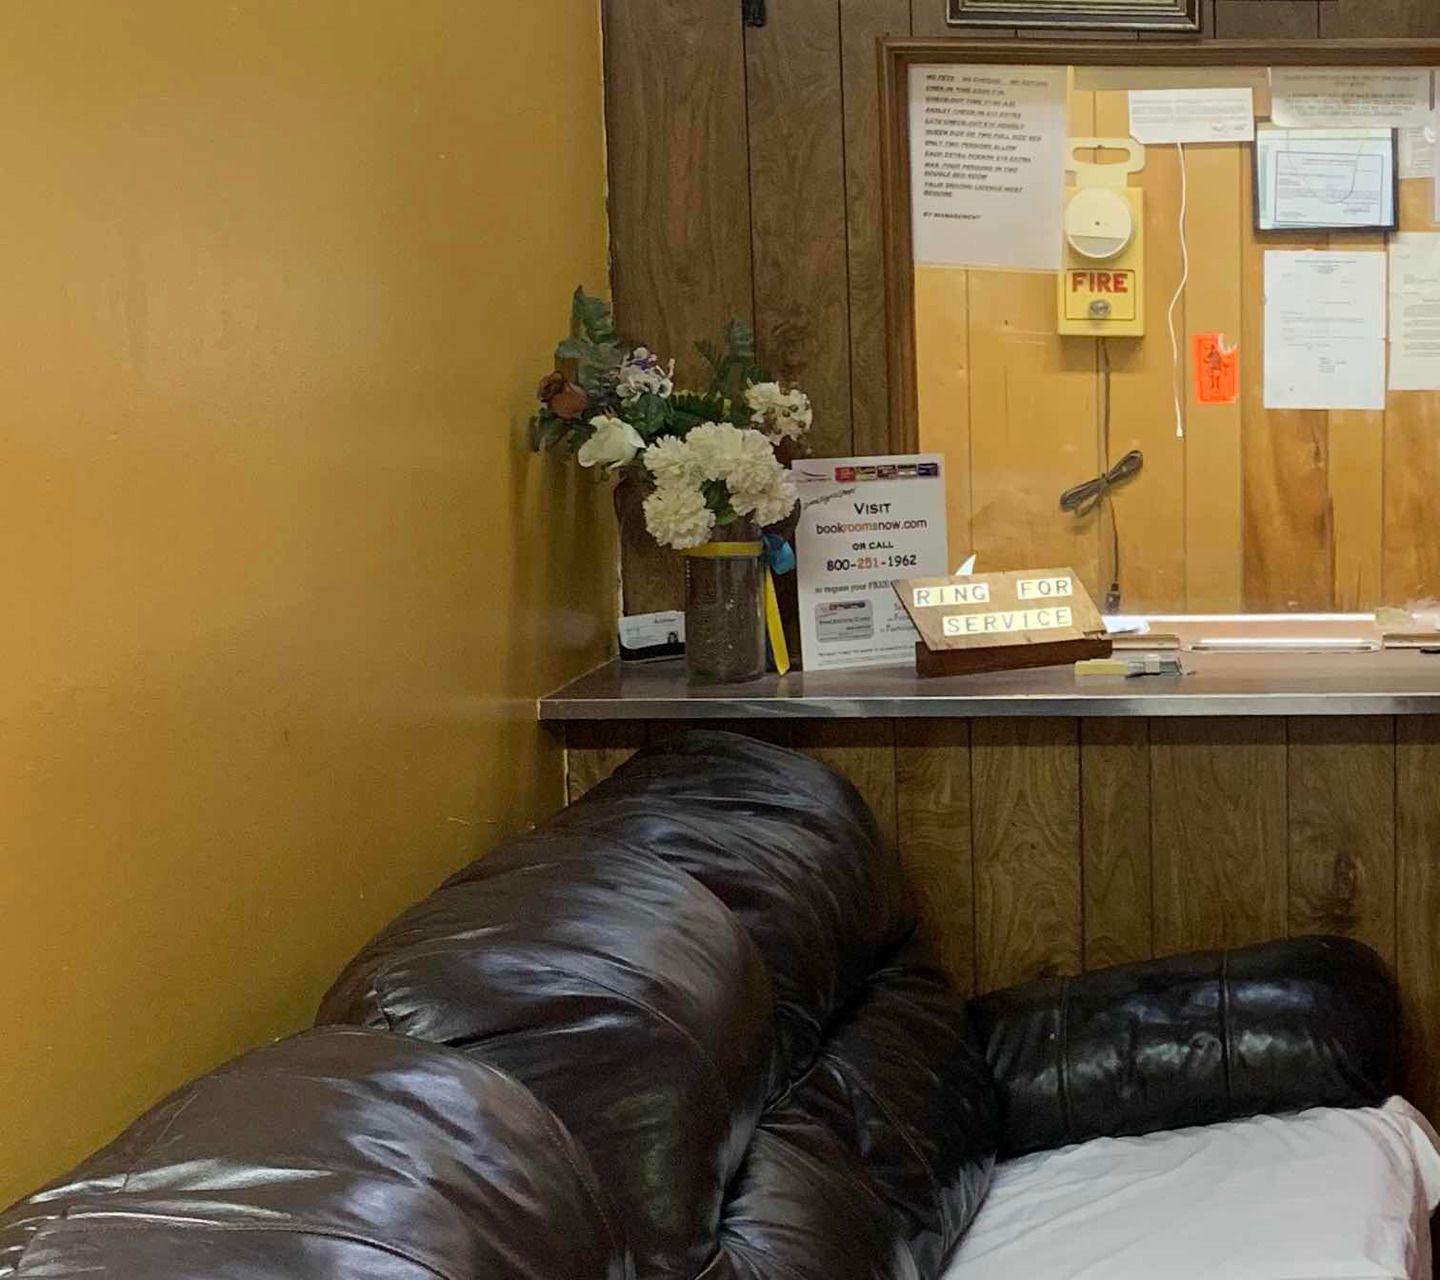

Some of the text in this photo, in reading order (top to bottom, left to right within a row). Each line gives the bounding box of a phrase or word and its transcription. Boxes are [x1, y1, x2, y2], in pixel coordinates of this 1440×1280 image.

[1071, 272, 1129, 294] FIRE
[816, 519, 927, 535] bookroomsnow.com
[852, 541, 894, 550] OR CALL
[827, 555, 917, 571] 800-251-1962
[916, 580, 1069, 606] RING FOR
[947, 609, 1070, 633] SERVICE
